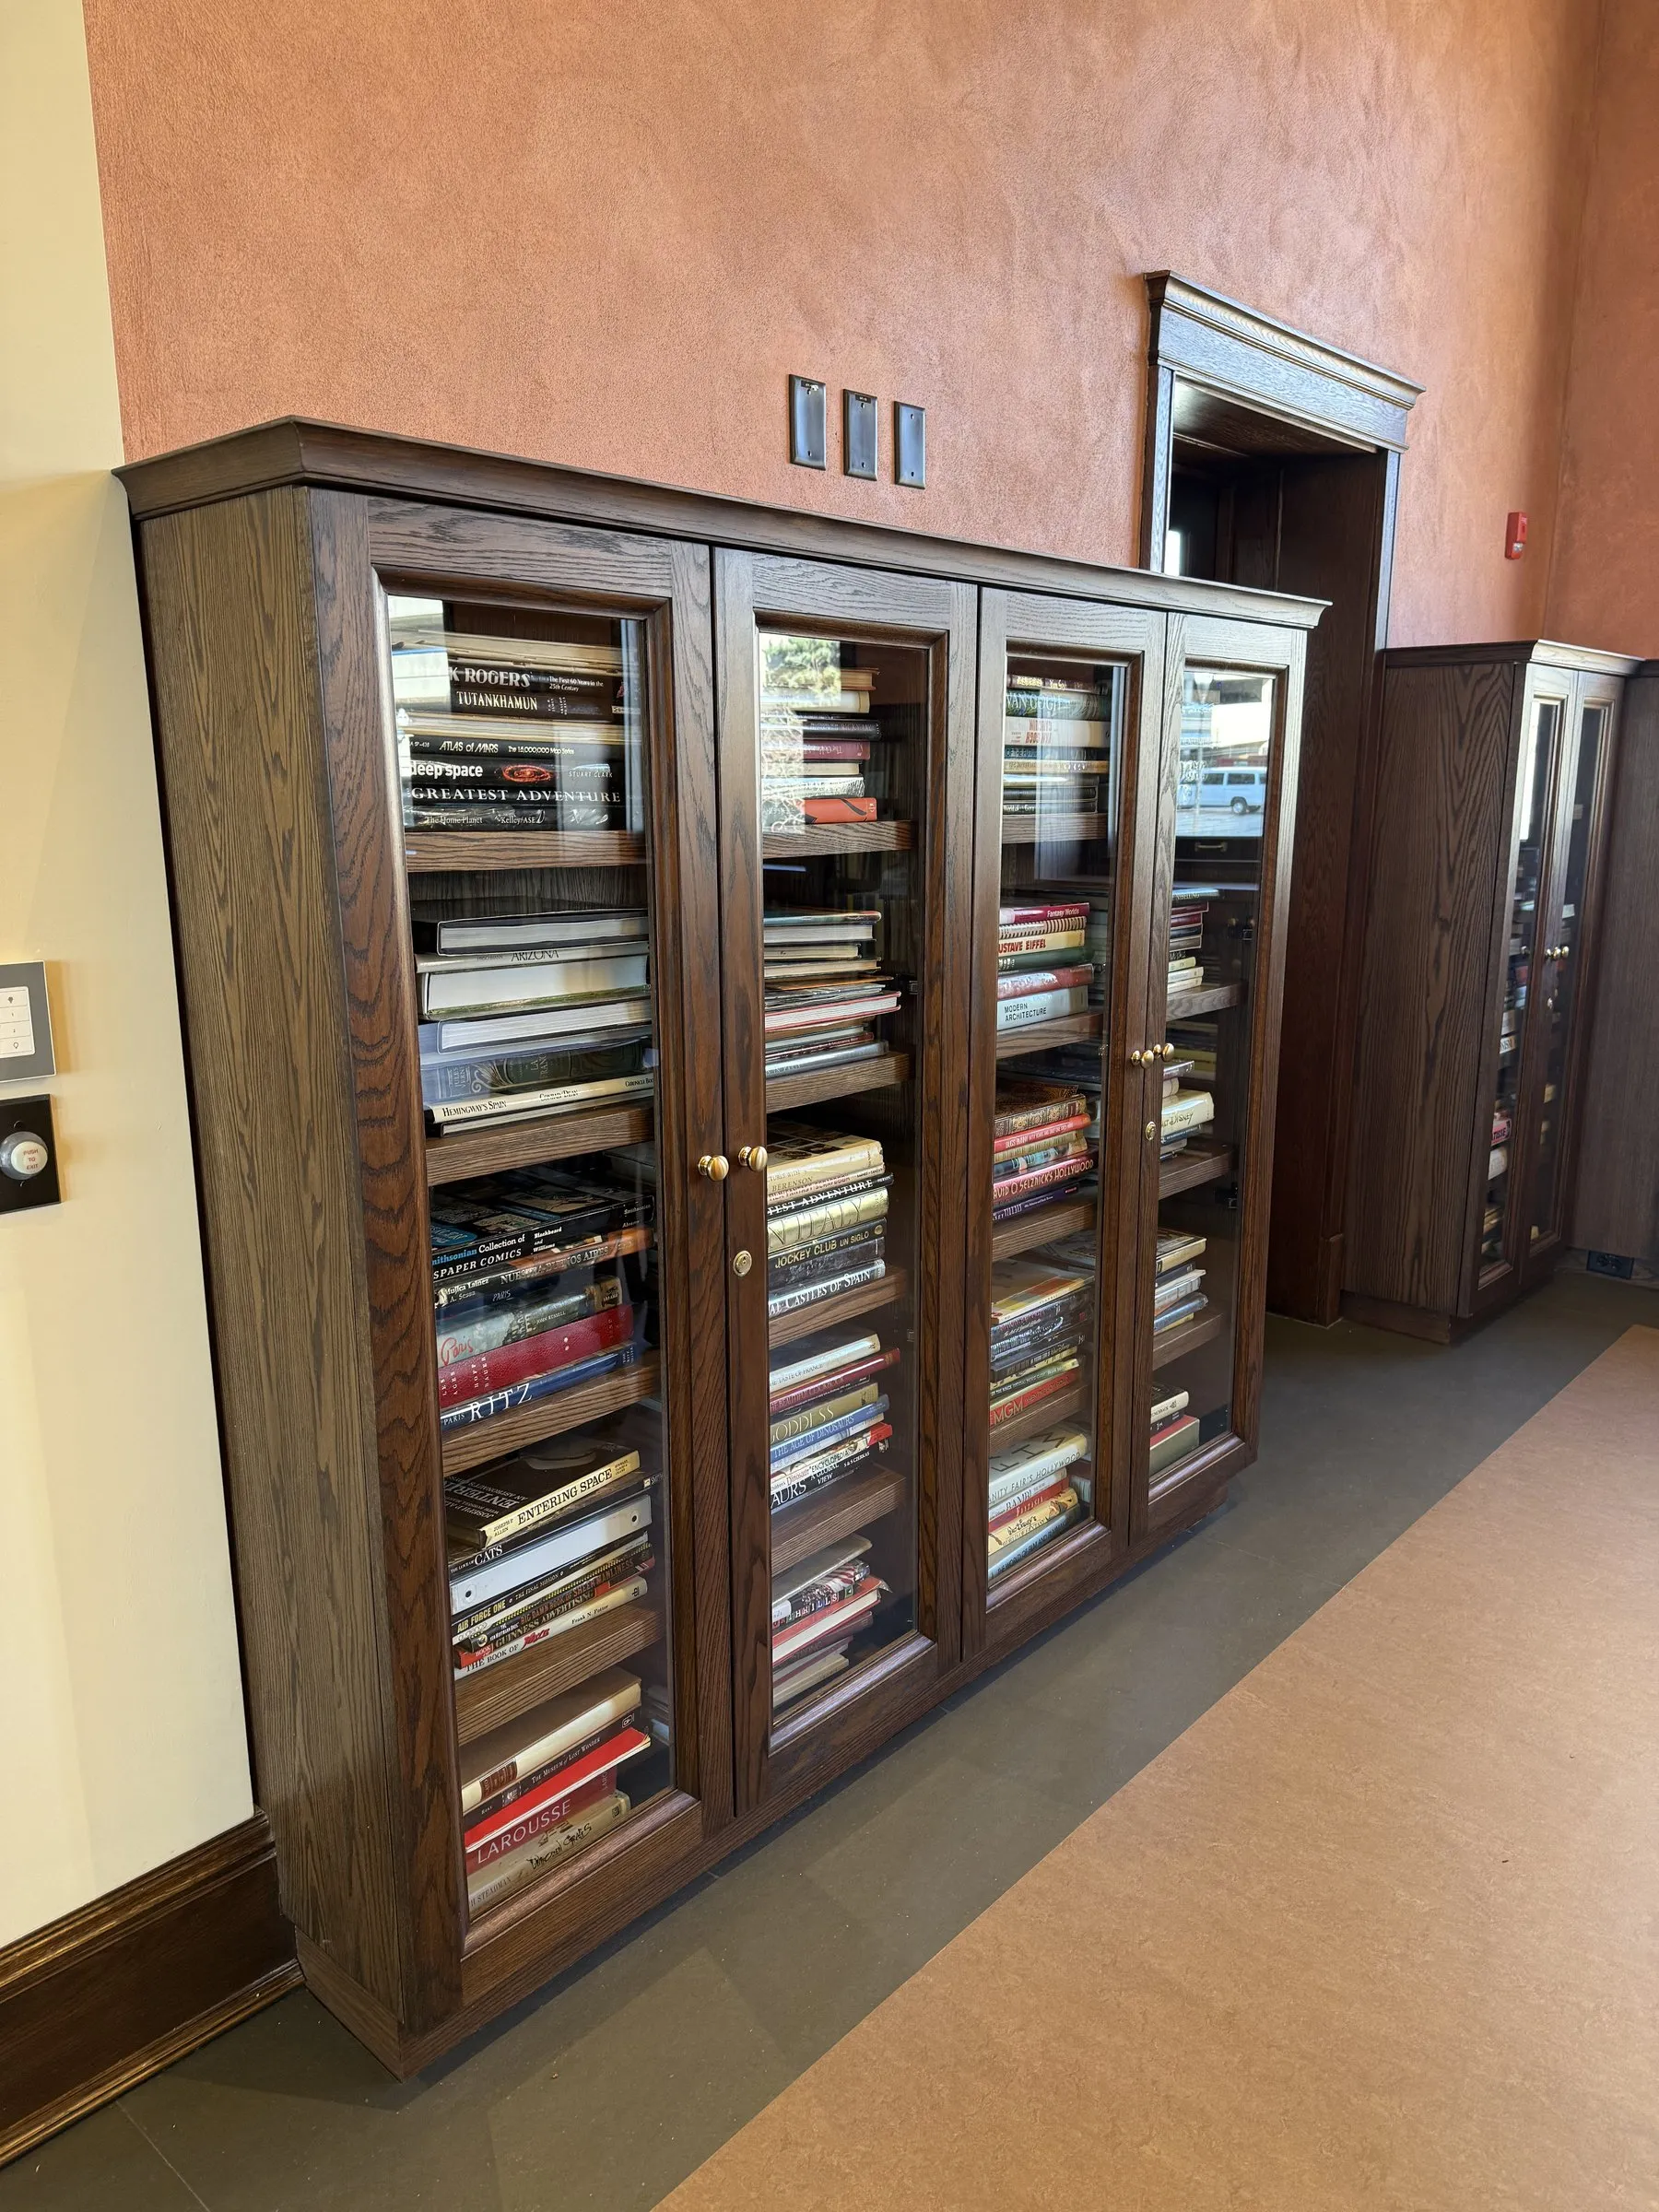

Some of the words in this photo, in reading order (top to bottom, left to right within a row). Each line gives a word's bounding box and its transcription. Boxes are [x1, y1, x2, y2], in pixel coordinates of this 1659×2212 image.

[465, 667, 531, 688] ROGERS
[561, 684, 580, 692] Century
[456, 691, 538, 711] TUTANKHAMUN
[440, 740, 464, 752] ATLAS
[465, 742, 475, 752] of
[475, 743, 499, 754] MARS
[445, 764, 484, 780] space
[411, 787, 509, 801] GREATEST
[516, 789, 621, 803] ADVENTURE
[462, 816, 483, 824] Planet
[1047, 909, 1065, 918] Fantasy
[1065, 907, 1079, 916] Worlds
[1025, 938, 1047, 950] EIFFEL
[511, 949, 559, 962] ARIZONA
[1004, 1003, 1028, 1014] MODERN
[1005, 1006, 1047, 1022] ARCHITECTURE
[442, 1103, 488, 1117] HEMINGWAY'S
[488, 1100, 508, 1111] SPAIN
[771, 1176, 813, 1192] BERENSON
[1018, 1171, 1053, 1193] SELZNICK'S
[1054, 1159, 1094, 1182] HOLLYWOOD
[801, 1179, 874, 1206] ADVENTURE
[534, 1226, 562, 1240] Blackbeard
[478, 1237, 517, 1253] Collection
[517, 1234, 526, 1243] of
[774, 1249, 811, 1269] JOCKEY
[814, 1241, 838, 1255] CLUB
[840, 1238, 849, 1247] UN
[850, 1231, 870, 1243] SIGLO
[479, 1248, 523, 1267] COMICS
[785, 1285, 828, 1309] CASTLES
[830, 1282, 842, 1293] OF
[844, 1271, 871, 1288] SPAIN
[440, 1336, 474, 1367] Paris
[443, 1413, 466, 1426] PARIS
[469, 1382, 533, 1423] RITZ
[994, 1398, 1024, 1424] MGM
[774, 1446, 790, 1458] THE
[790, 1439, 806, 1453] AGE
[806, 1434, 816, 1444] OF
[817, 1416, 854, 1438] DINOSAURS
[818, 1472, 833, 1486] VIEW
[1010, 1476, 1034, 1493] FAIR'S
[1036, 1452, 1081, 1479] HOLLYWOOD
[516, 1484, 579, 1525] ENTERING
[580, 1468, 613, 1494] SPACE
[474, 1543, 503, 1567] CATS
[457, 1618, 469, 1634] AIR
[470, 1609, 492, 1626] FORCE
[493, 1599, 507, 1614] ONE
[496, 1618, 540, 1648] GUINNESS
[541, 1590, 594, 1623] ADVERTISING
[571, 1614, 586, 1624] Frank
[465, 1656, 485, 1673] THE
[487, 1648, 507, 1663] BOOK
[509, 1643, 519, 1653] OF
[530, 1774, 542, 1785] THE
[542, 1761, 563, 1777] MUSEUM
[568, 1749, 581, 1760] LOST
[581, 1736, 601, 1752] WONDER
[477, 1798, 572, 1864] LAROUSSE
[477, 1876, 512, 1903] STEADMAN
